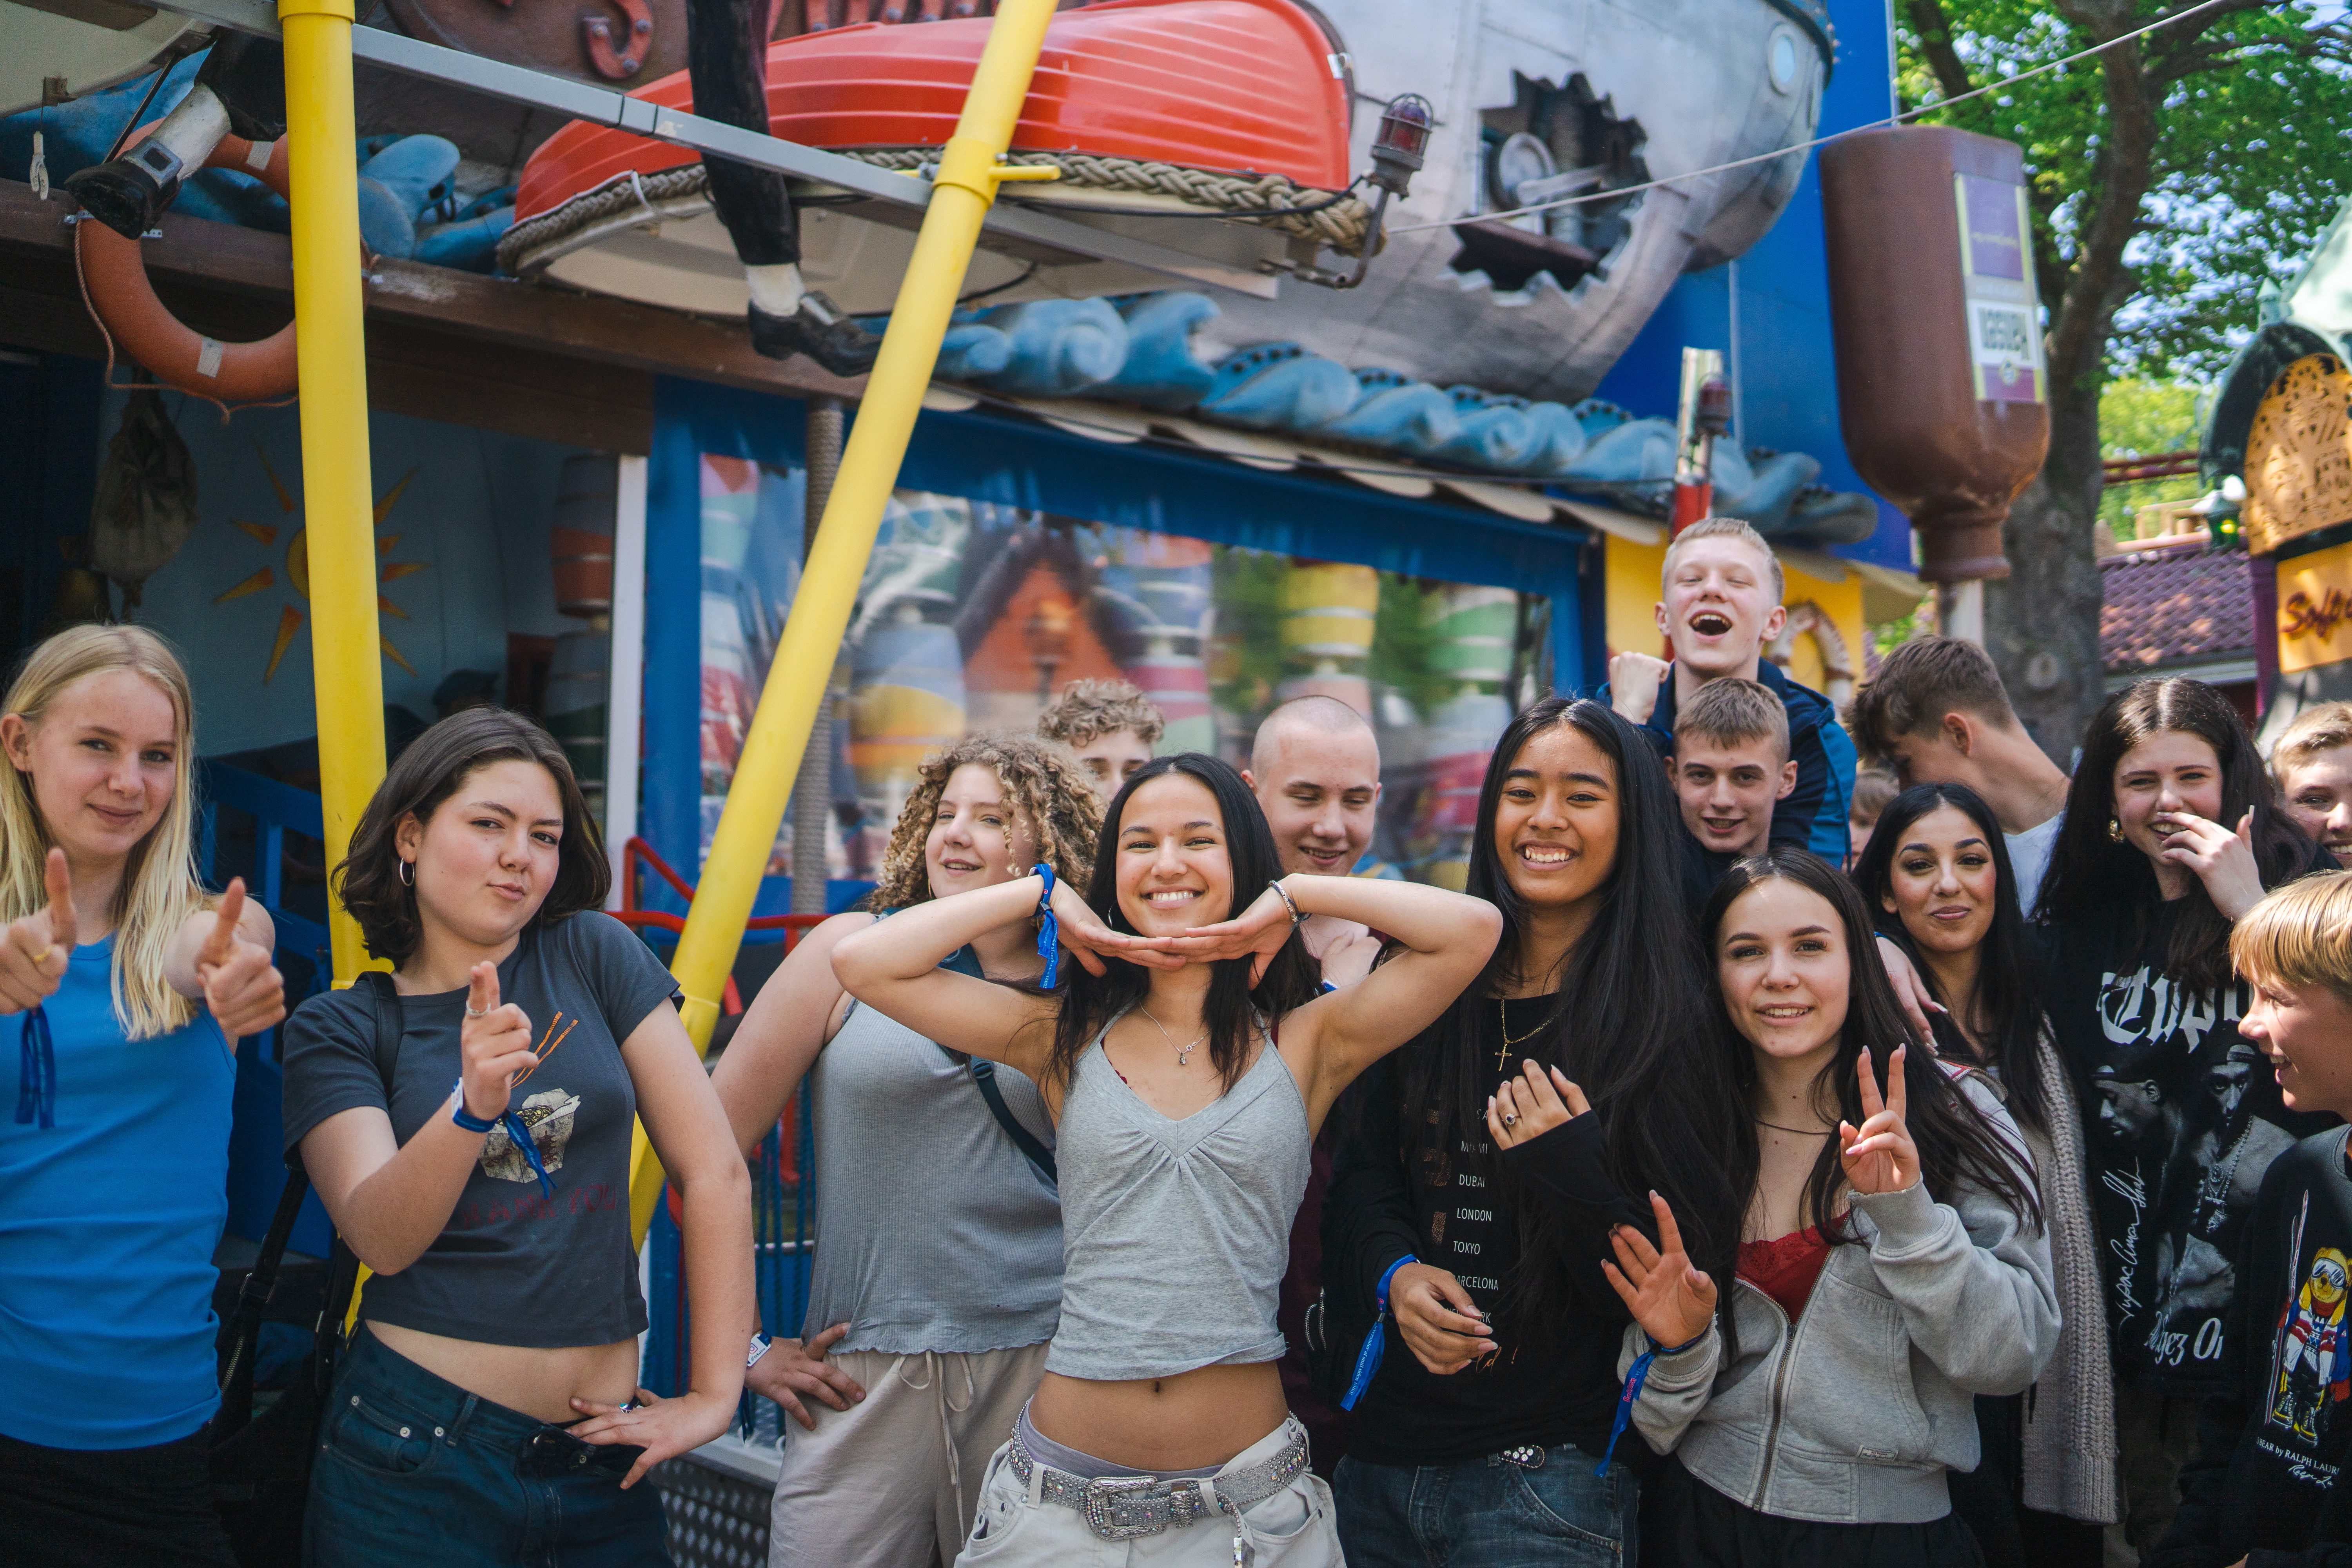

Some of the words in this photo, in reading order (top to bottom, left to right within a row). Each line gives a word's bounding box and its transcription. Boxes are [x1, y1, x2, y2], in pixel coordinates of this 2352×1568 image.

[1459, 1174, 1485, 1188] DUBAI
[444, 1193, 556, 1231] HANK
[568, 1183, 616, 1215] YOU
[1457, 1207, 1492, 1221] LONDON
[1453, 1241, 1481, 1255] TOKYO
[1454, 1275, 1499, 1290] ARCELONA
[2276, 1445, 2284, 1457] by
[2284, 1449, 2312, 1466] RALPH
